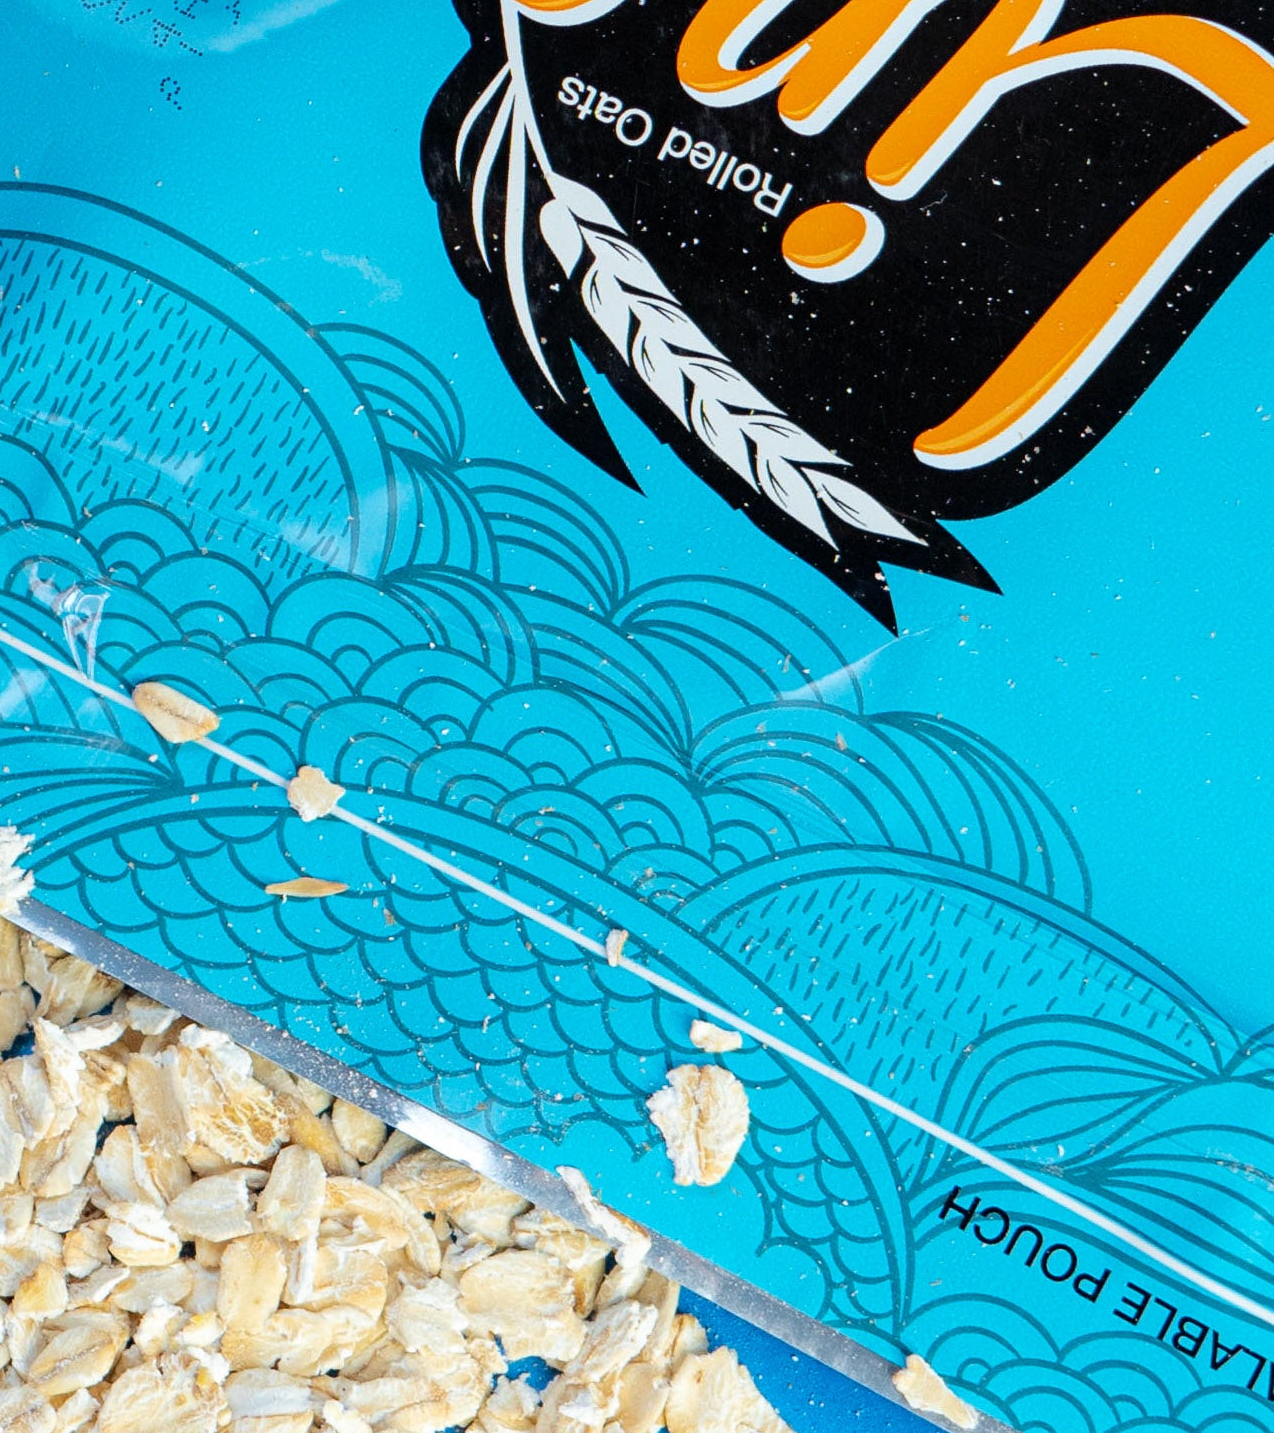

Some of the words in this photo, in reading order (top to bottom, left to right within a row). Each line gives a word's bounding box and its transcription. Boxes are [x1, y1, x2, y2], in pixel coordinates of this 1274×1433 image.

[557, 76, 656, 150] Oats
[658, 126, 794, 219] Rolled
[938, 1185, 1112, 1304] POUCH
